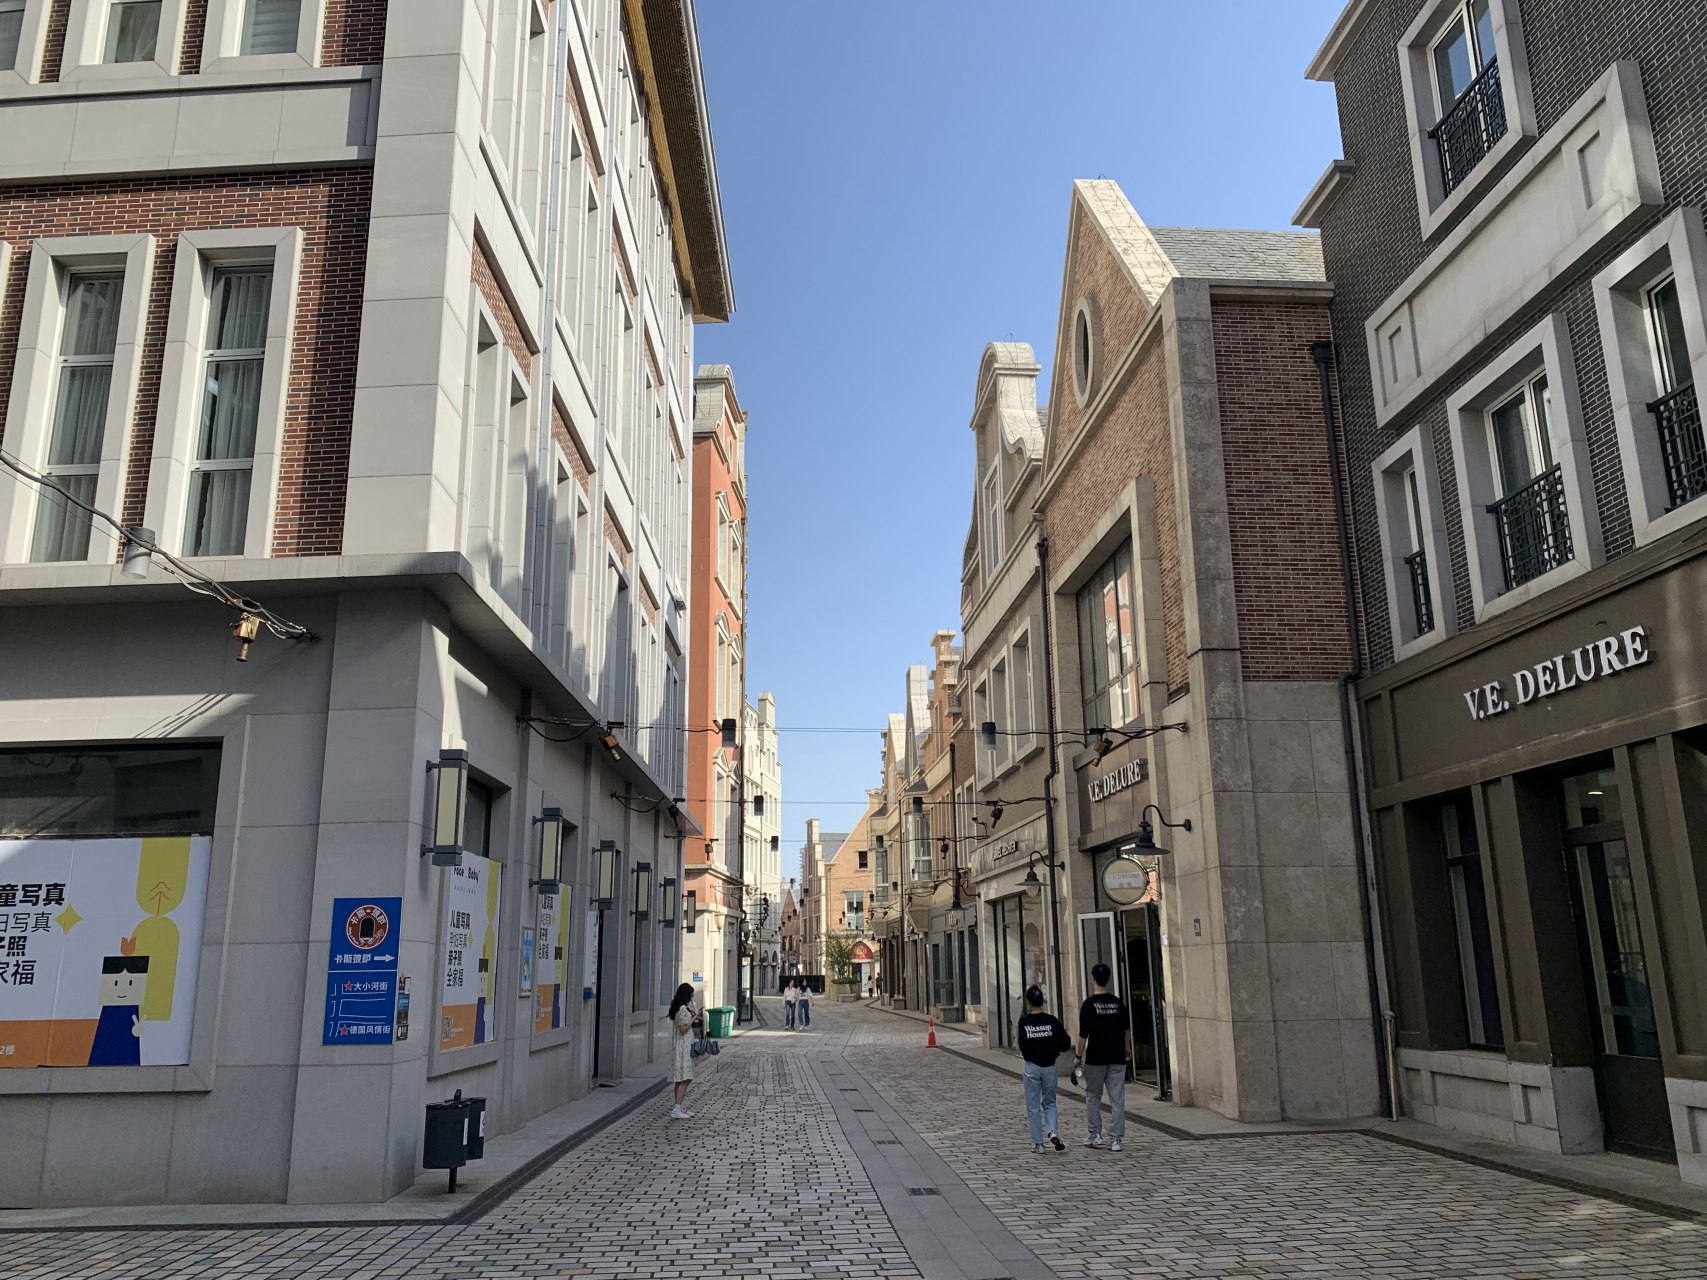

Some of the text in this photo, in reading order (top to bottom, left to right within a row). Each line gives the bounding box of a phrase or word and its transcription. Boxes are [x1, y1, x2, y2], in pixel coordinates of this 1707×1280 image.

[1463, 625, 1649, 721] V.E. DELURE
[1087, 759, 1141, 803] V.E. DELURE
[450, 909, 471, 931] 儿童写真
[353, 981, 389, 991] 大小河街
[446, 968, 464, 988] 全家福
[349, 1025, 391, 1035] 德国风情街
[1024, 1024, 1052, 1032] Wassup
